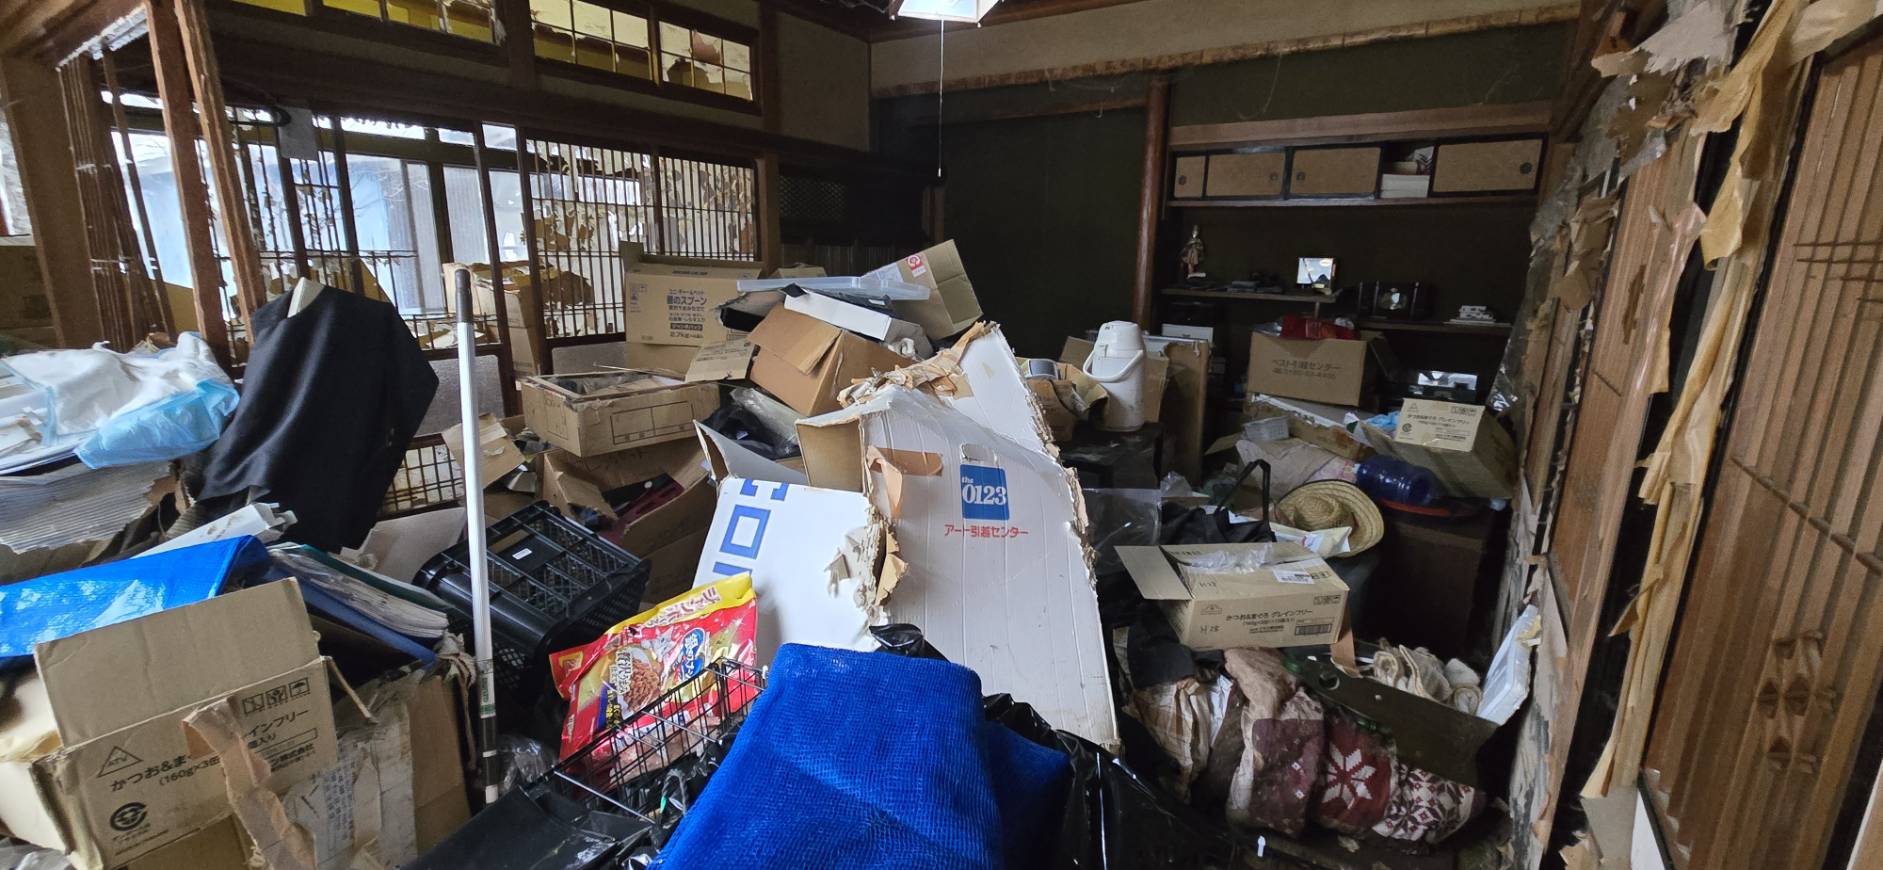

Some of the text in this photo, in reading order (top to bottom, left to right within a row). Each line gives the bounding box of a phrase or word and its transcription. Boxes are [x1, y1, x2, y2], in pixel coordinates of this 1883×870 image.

[962, 483, 1007, 505] 0123
[243, 710, 309, 739] インフリー
